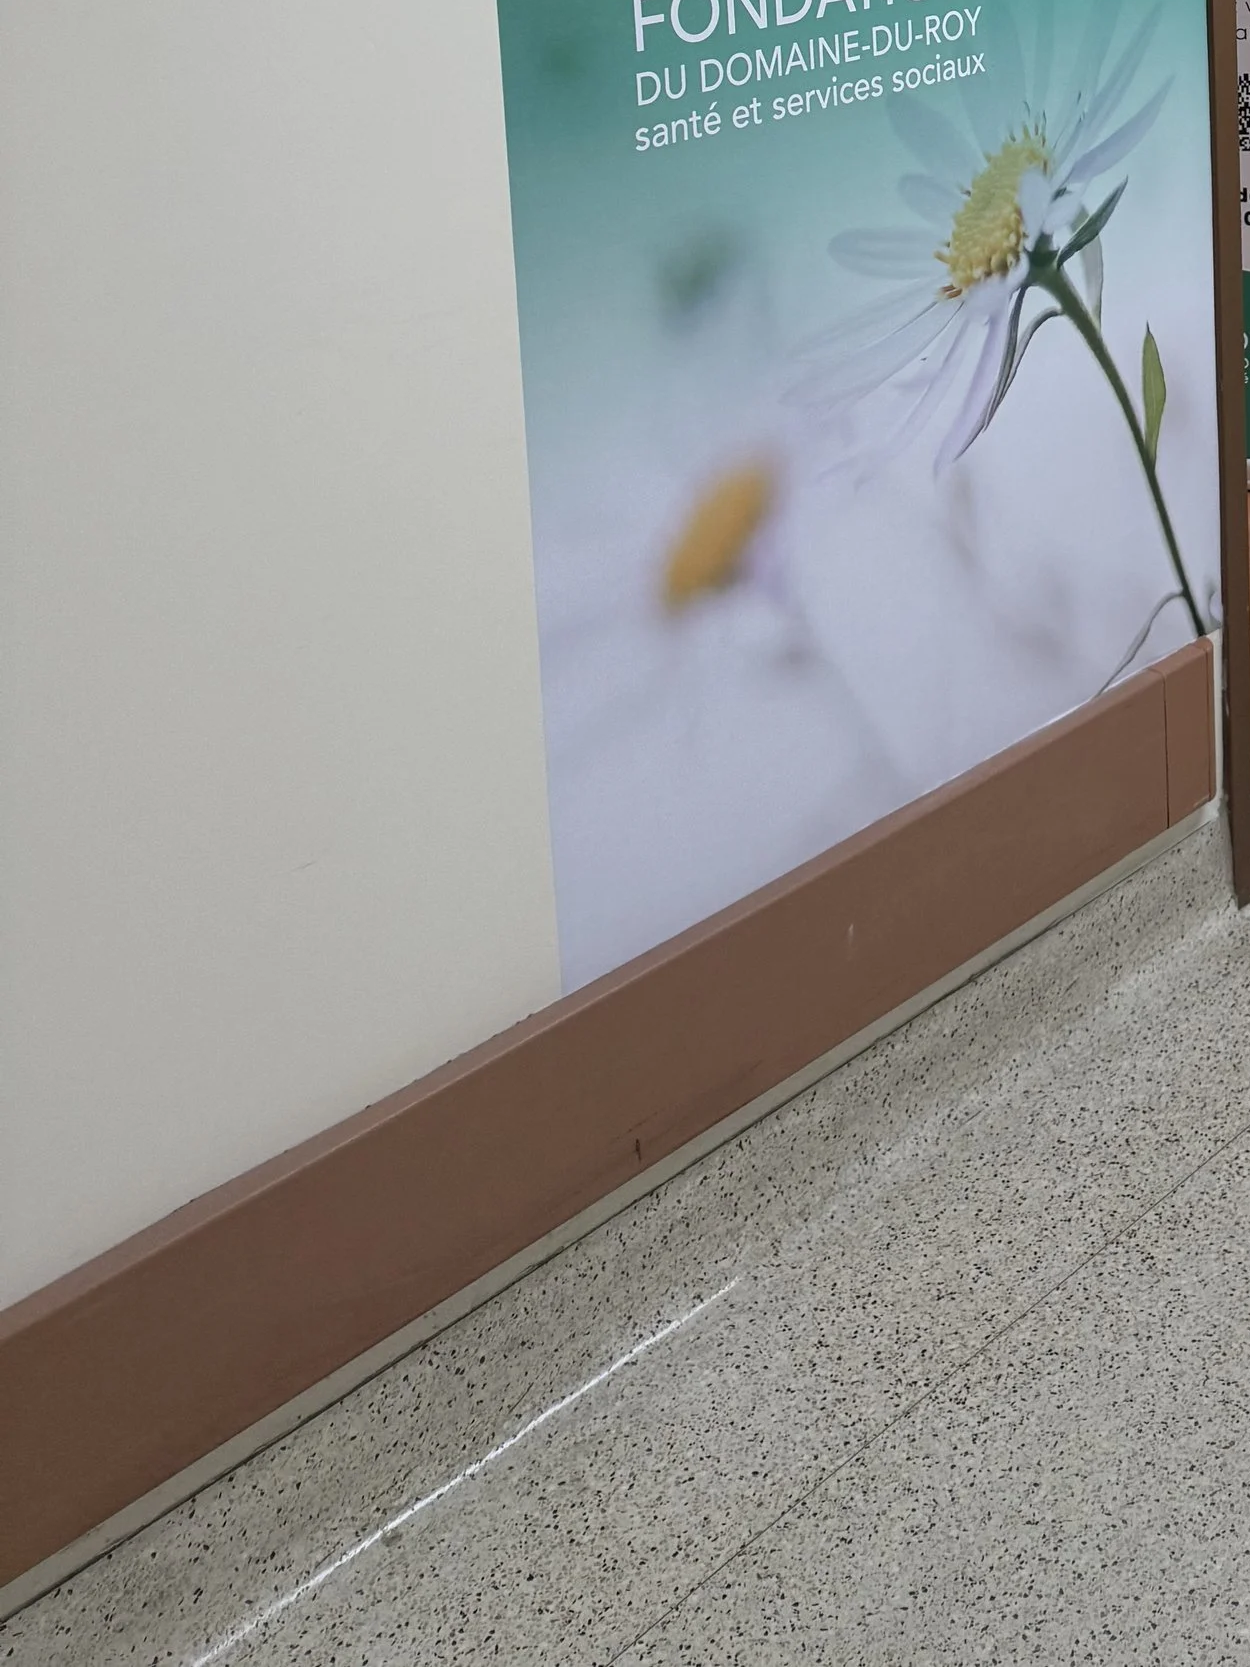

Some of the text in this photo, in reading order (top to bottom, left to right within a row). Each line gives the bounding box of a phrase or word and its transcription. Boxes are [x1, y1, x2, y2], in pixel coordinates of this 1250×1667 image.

[634, 52, 986, 152] santé et services sociaux
[635, 5, 983, 107] DU DOMAINE-DU-ROY
